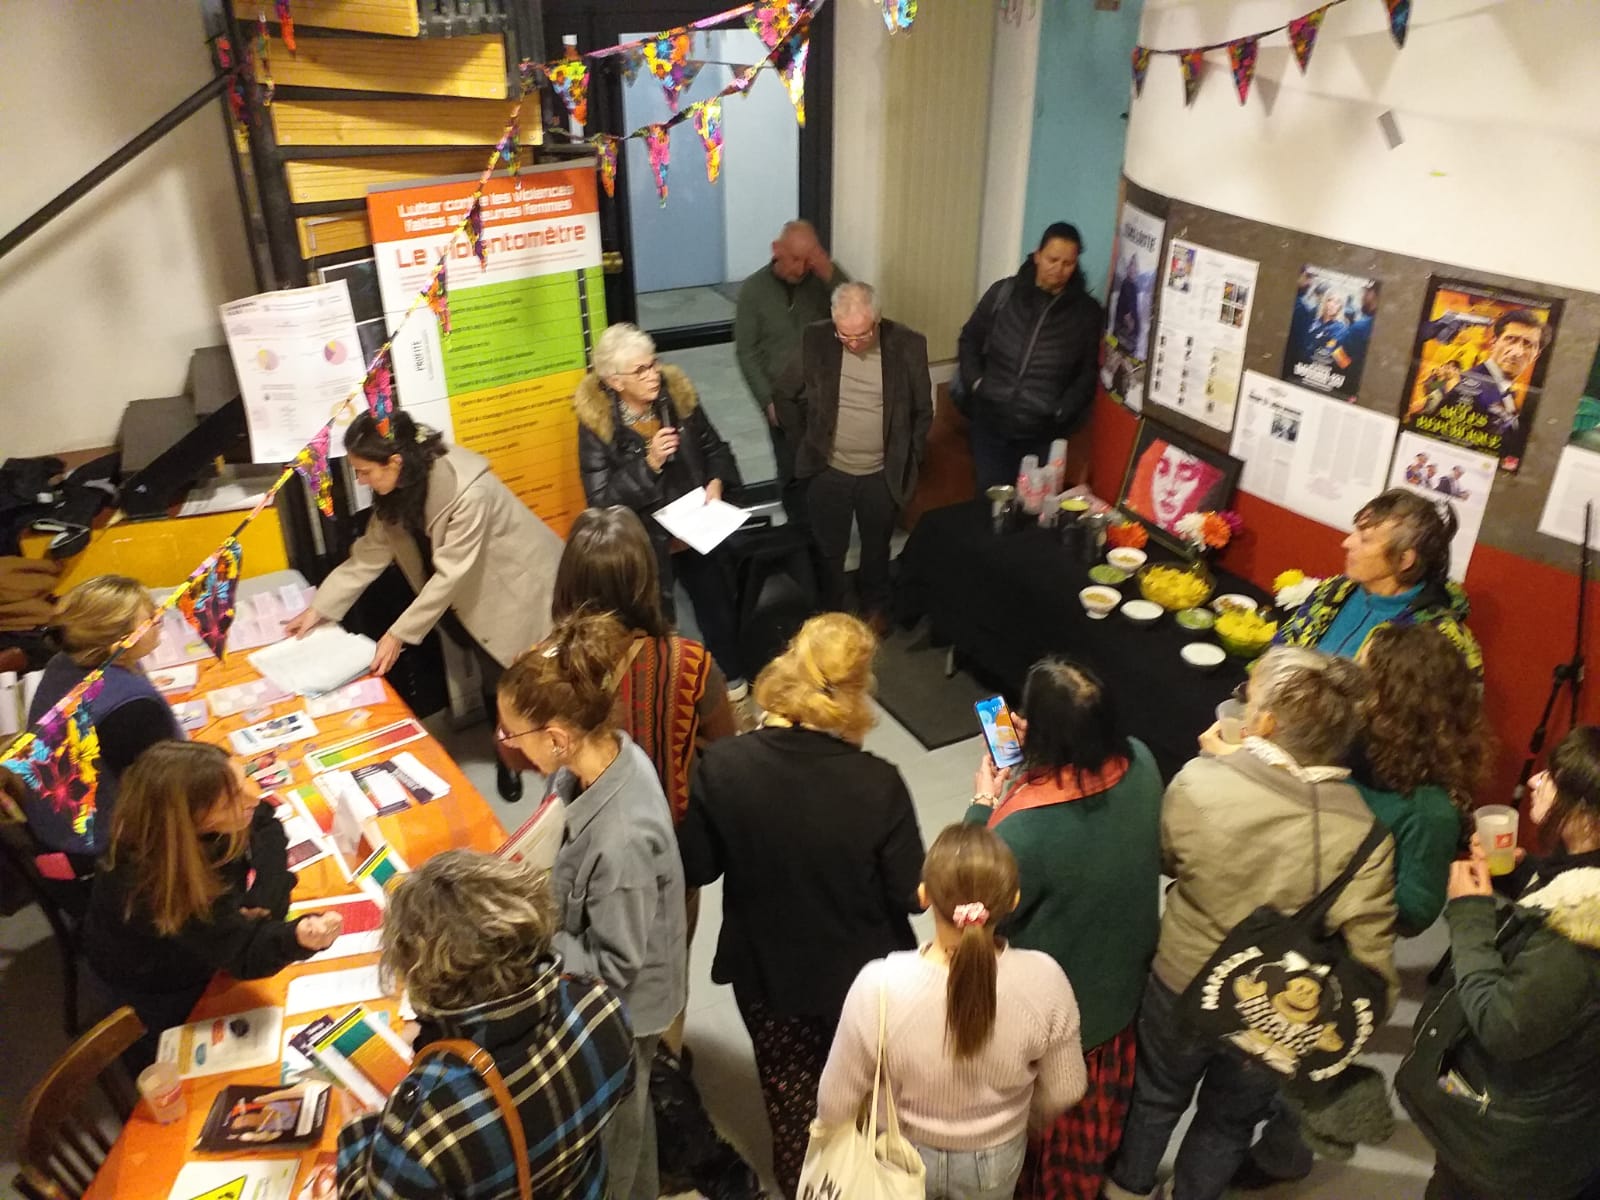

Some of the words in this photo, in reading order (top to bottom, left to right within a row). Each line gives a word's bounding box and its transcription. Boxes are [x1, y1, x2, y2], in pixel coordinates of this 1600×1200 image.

[398, 202, 441, 217] Lutter
[443, 195, 489, 212] conte
[490, 193, 513, 205] les
[524, 200, 573, 214] femmes
[395, 248, 427, 268] Le
